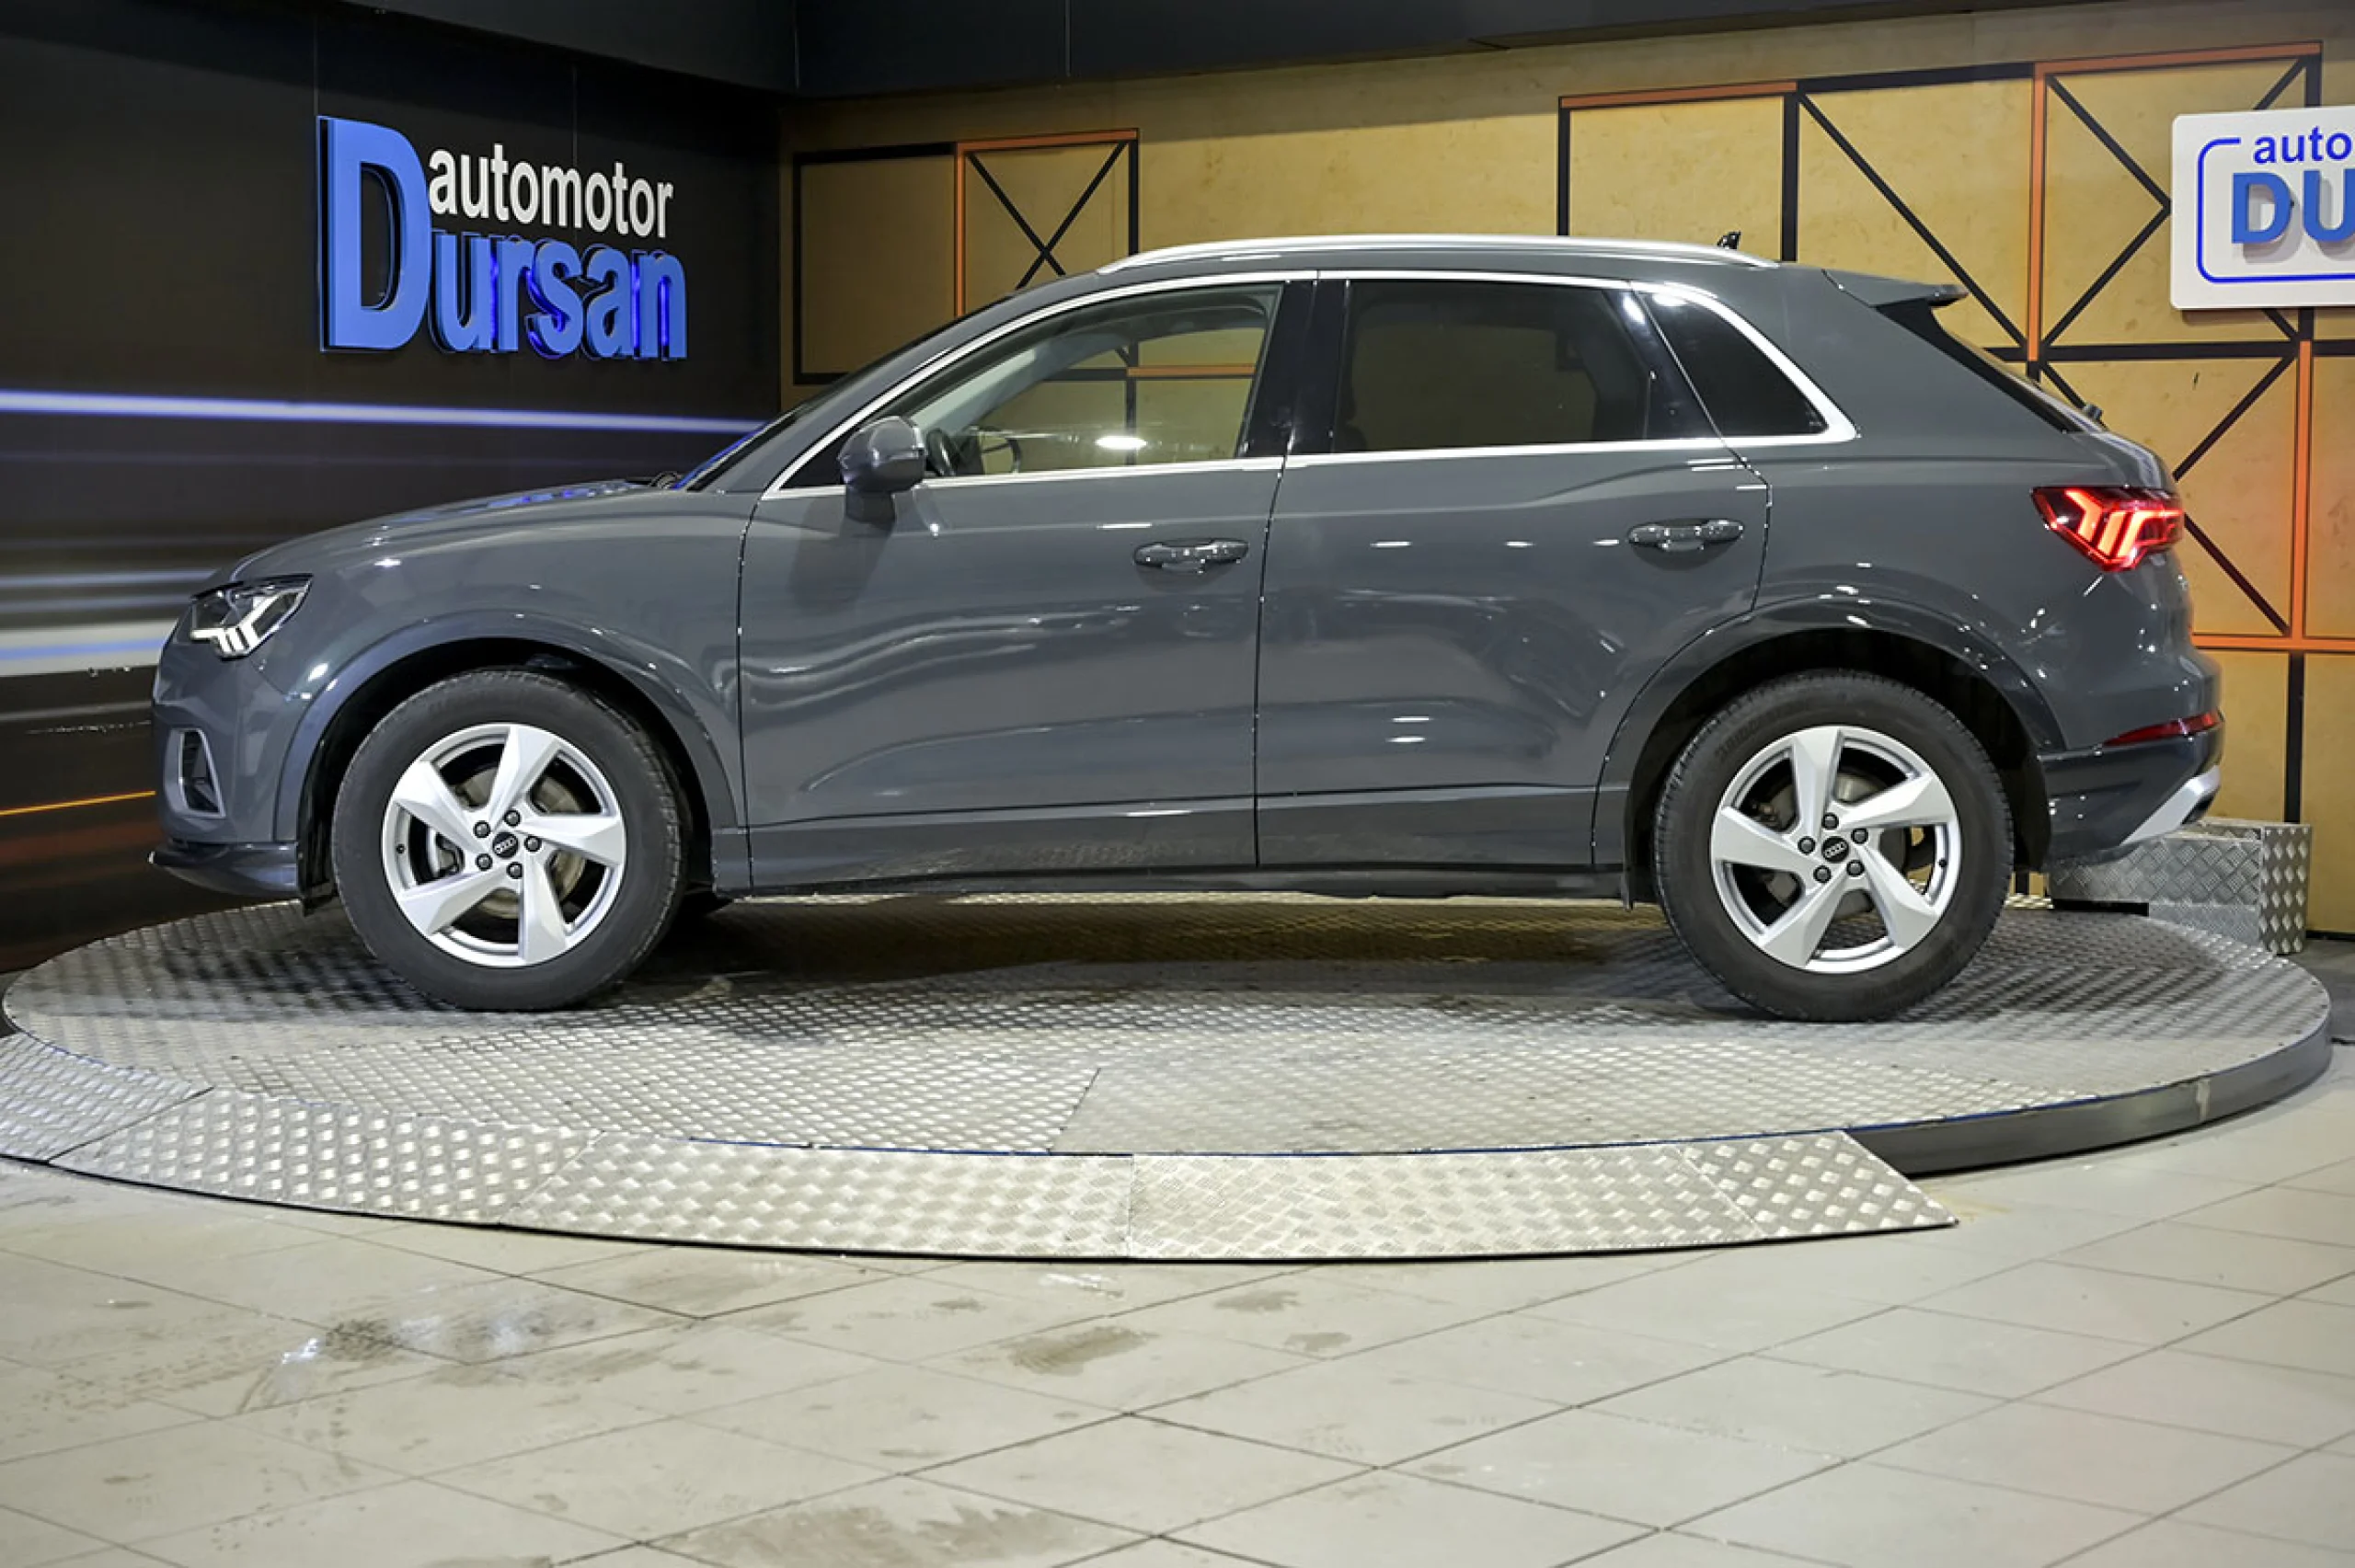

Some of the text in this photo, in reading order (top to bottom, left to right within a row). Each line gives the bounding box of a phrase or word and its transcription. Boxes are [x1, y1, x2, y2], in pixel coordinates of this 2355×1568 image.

[2253, 125, 2353, 164] auto
[429, 143, 674, 238] automotor
[2231, 167, 2355, 245] DU
[317, 115, 687, 361] Dursan
